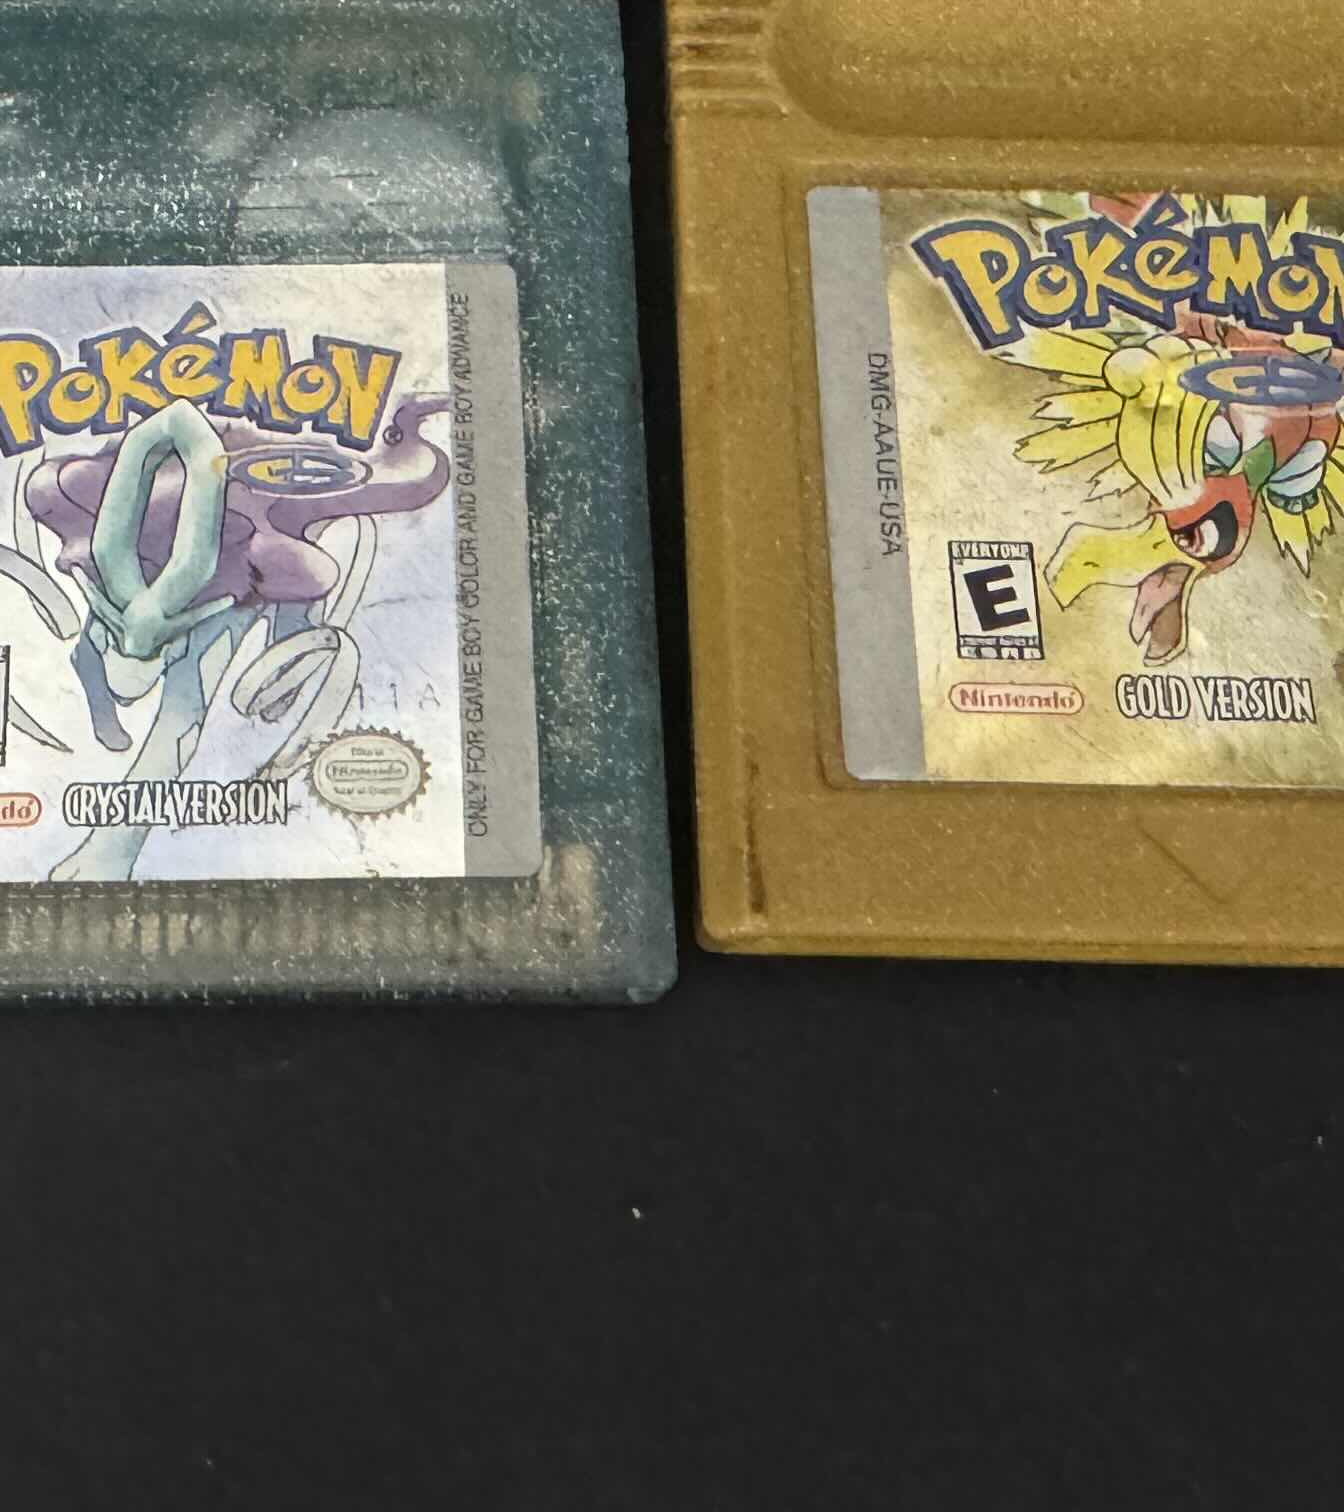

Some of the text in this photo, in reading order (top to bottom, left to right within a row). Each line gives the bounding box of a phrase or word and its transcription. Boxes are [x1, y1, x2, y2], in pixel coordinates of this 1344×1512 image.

[450, 294, 488, 839] ONLY FOR GAME BOY COLOR AND GAME BOY ADVANCE
[952, 542, 1030, 559] EVERYONE
[963, 564, 1031, 632] E
[959, 687, 1076, 710] Nintendo
[1114, 674, 1318, 724] GOLD VERSION
[62, 778, 289, 828] CRYSTAL VERSION
